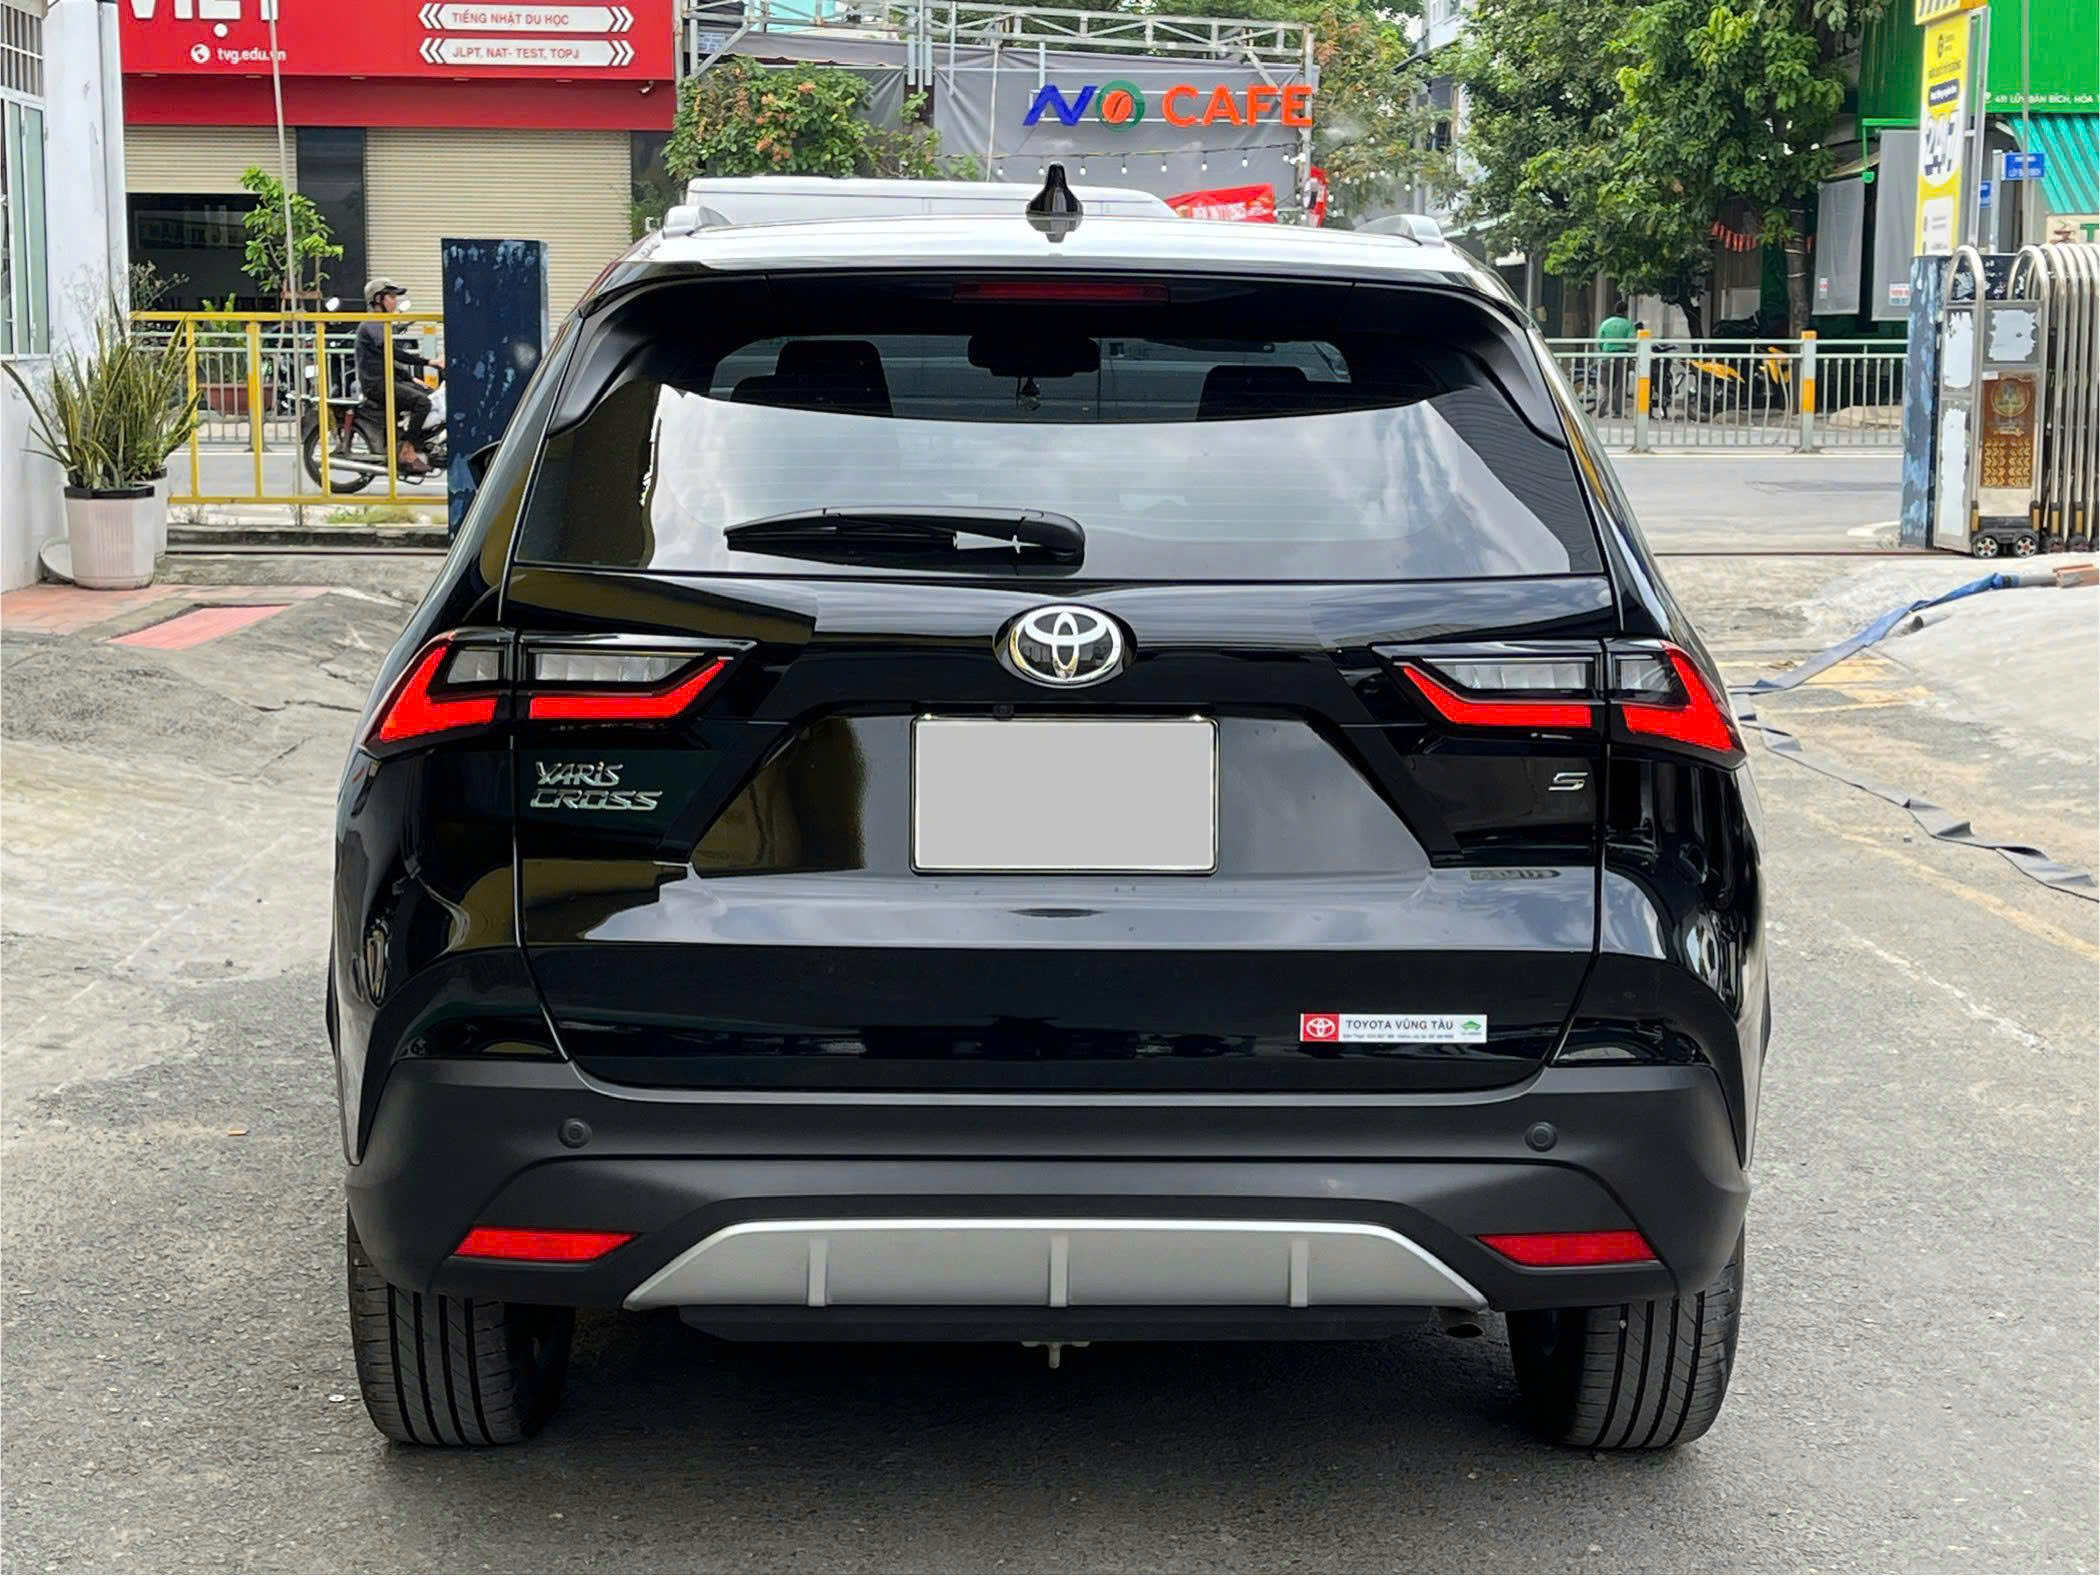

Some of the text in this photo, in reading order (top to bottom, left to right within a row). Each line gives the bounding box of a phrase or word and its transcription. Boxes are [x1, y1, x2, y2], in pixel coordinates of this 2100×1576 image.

[452, 9, 569, 27] TIẾNG NHẬT DU HỌC
[550, 48, 580, 59] TOPJ
[1162, 83, 1313, 128] CAFE
[1549, 772, 1588, 791] S
[530, 788, 662, 810] CROSS
[1346, 1018, 1454, 1031] TOYOTA VŨNG TÀU
